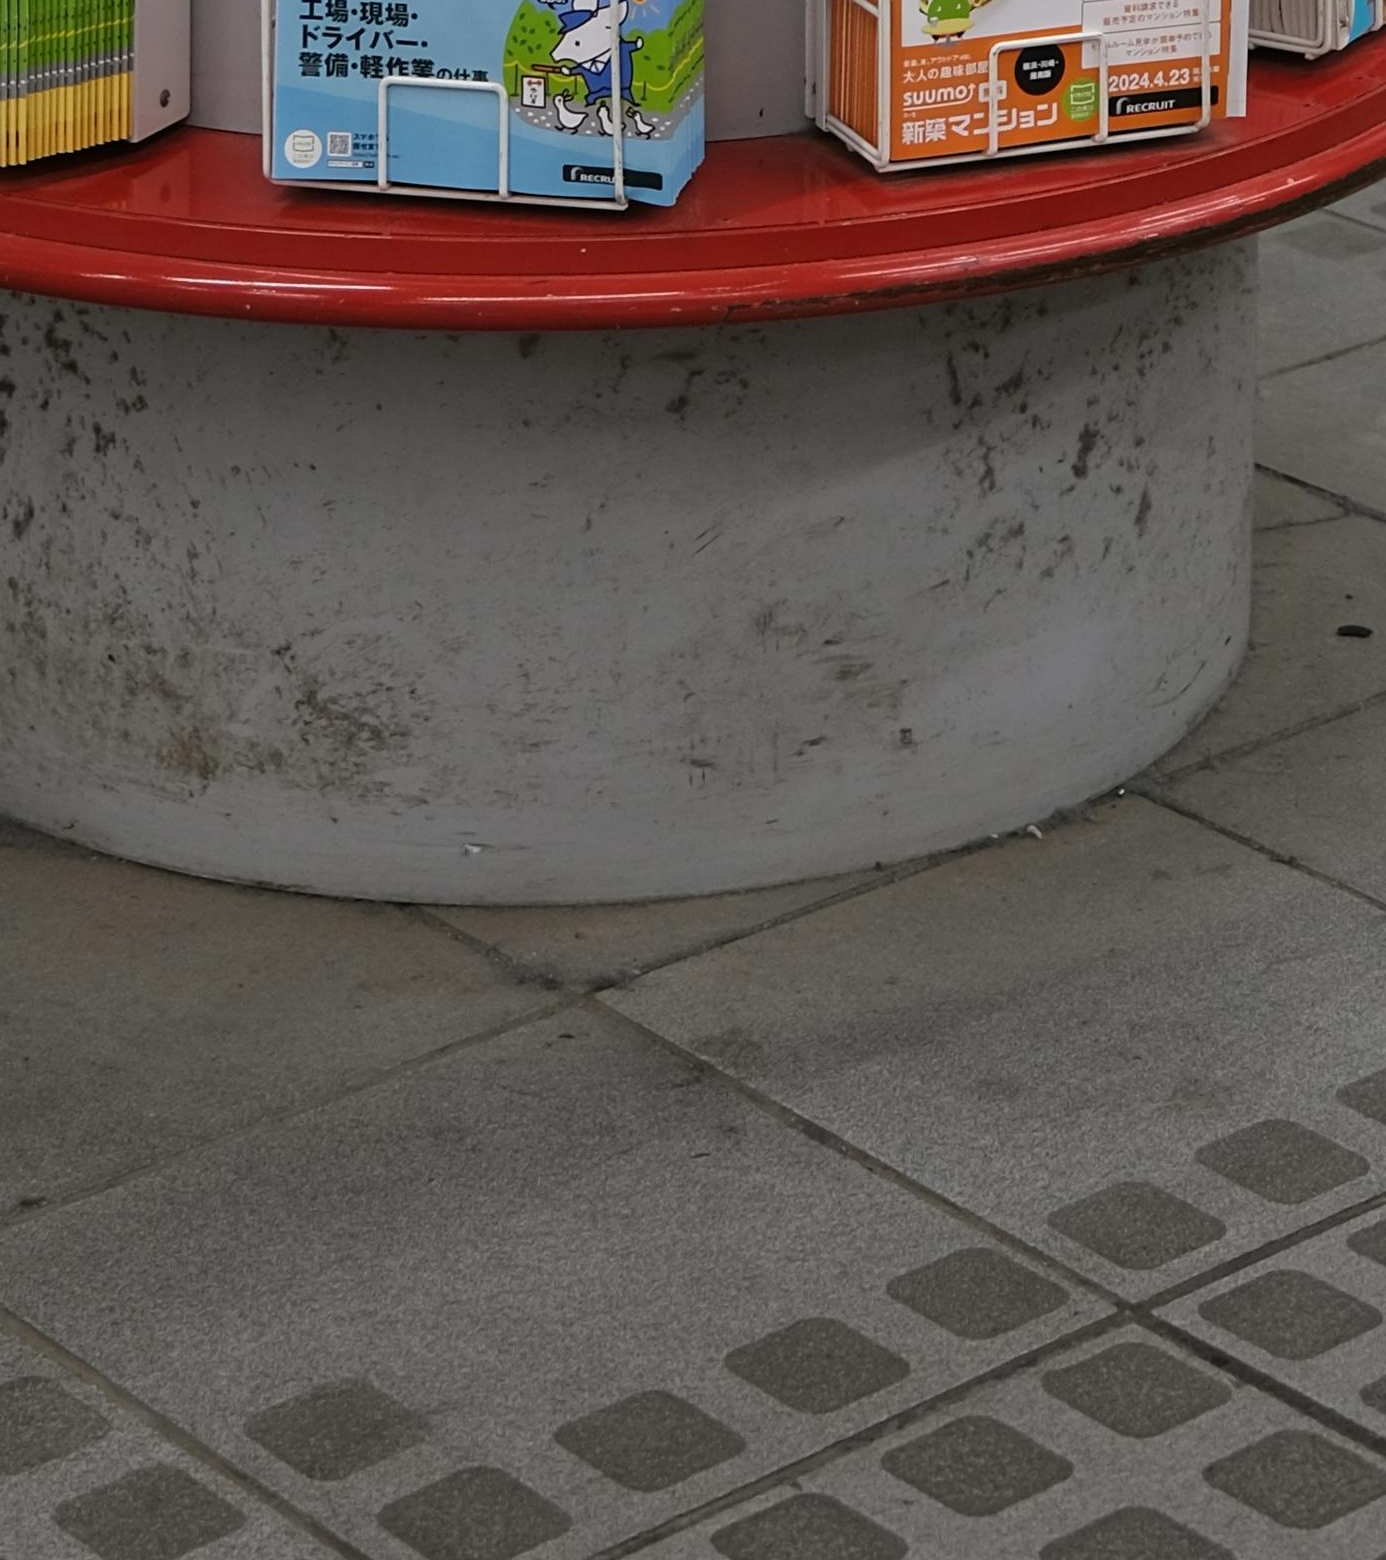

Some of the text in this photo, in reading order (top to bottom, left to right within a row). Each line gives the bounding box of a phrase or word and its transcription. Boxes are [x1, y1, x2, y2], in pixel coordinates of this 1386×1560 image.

[1124, 0, 1179, 13] 資料請求できる
[300, 25, 429, 51] ドライバー・
[1126, 45, 1177, 56] マンション特集
[1109, 68, 1190, 92] 2024.4.23
[903, 85, 967, 106] suumo
[1126, 99, 1175, 113] RECRUIT
[902, 103, 1058, 145] 新築マンション
